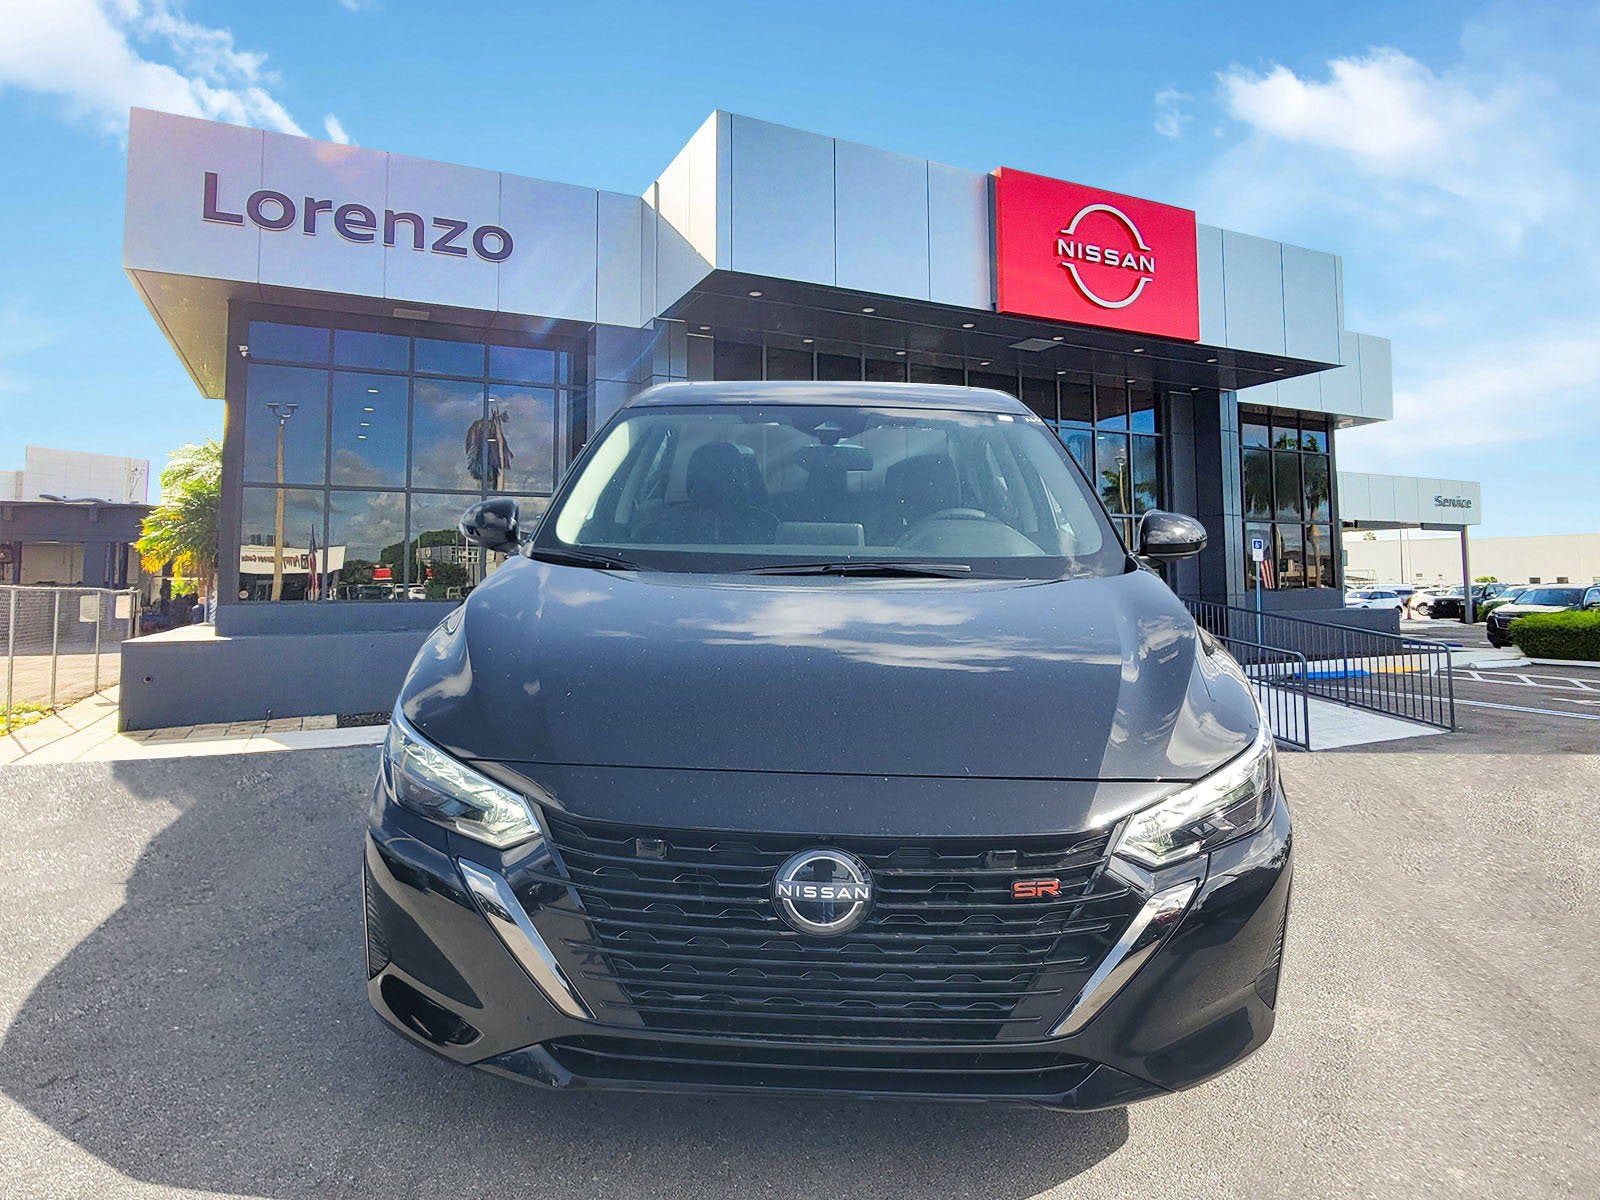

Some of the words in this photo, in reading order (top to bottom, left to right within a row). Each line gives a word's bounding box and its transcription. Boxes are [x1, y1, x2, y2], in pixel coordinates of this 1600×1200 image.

[203, 171, 514, 262] Lorenzo
[1057, 238, 1155, 273] NISSAN
[1434, 495, 1472, 508] Service
[777, 883, 870, 900] NISSAN
[1012, 879, 1061, 898] SR
